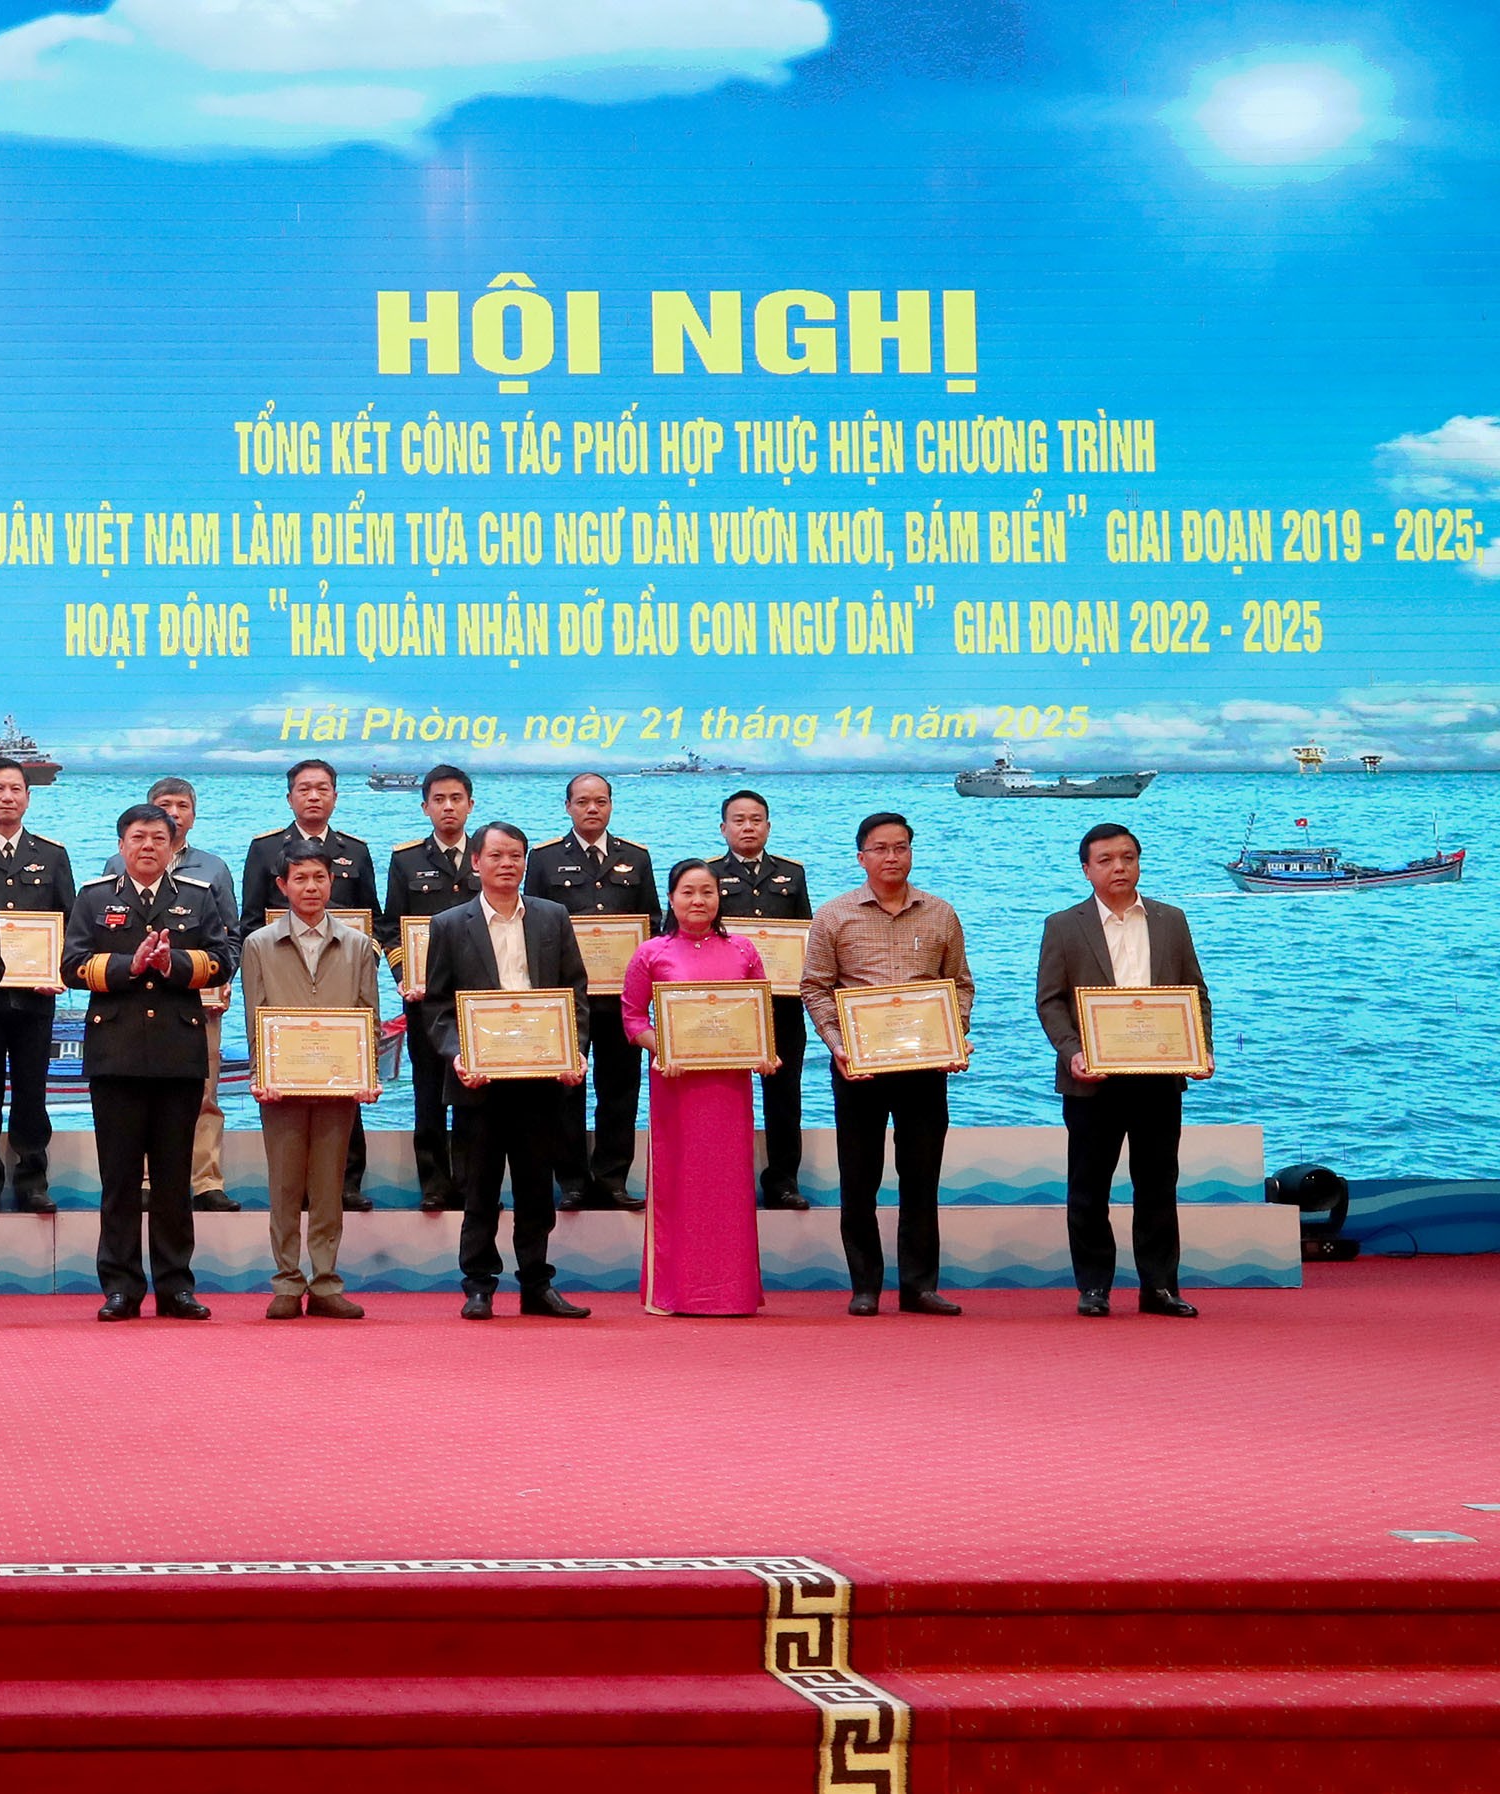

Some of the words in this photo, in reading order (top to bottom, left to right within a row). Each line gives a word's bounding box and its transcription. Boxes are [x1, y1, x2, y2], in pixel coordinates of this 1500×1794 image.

[378, 272, 601, 393] HỘI
[652, 289, 977, 393] NGHỊ
[235, 400, 320, 475] TỔNG
[332, 403, 391, 474] KẾT
[402, 411, 490, 475] CÔNG
[501, 410, 561, 474] TÁC
[574, 403, 648, 474] PHỐI
[661, 416, 724, 487] HỢP
[735, 415, 817, 486] THỰC
[830, 410, 904, 486] HIỆN
[917, 415, 1048, 473] CHƯƠNG
[1058, 408, 1155, 472] TRÌNH
[65, 501, 133, 577] VIỆT
[145, 513, 220, 565] NAM
[233, 501, 301, 565] LÀM
[312, 489, 395, 564] ĐIỂM
[406, 506, 468, 577] TỰA
[479, 511, 542, 565] CHO
[555, 507, 625, 565] NGƯ
[633, 500, 699, 564] DÂN
[710, 506, 797, 564] VƯƠN
[808, 506, 894, 570] KHƠI,
[906, 499, 979, 563] BÁM
[1106, 509, 1171, 563] GIAI
[1181, 509, 1272, 575] ĐOẠN
[1283, 509, 1361, 562] 2019
[1373, 533, 1384, 544] -
[1395, 508, 1485, 568] 2025;
[65, 602, 149, 670] HOẠT
[159, 592, 250, 670] ĐỘNG
[356, 591, 446, 662] QUÂN
[458, 591, 549, 669] NHẬN
[559, 588, 605, 656] ĐỠ
[613, 584, 679, 655] ĐẦU
[690, 602, 757, 655] CON
[769, 596, 839, 655] NGƯ
[955, 601, 1019, 654] GIAI
[1029, 600, 1119, 666] ĐOẠN
[1130, 601, 1210, 653] 2022
[1221, 625, 1232, 635] -
[1243, 600, 1323, 653] 2025
[280, 703, 349, 741] Hải
[362, 706, 507, 749] Phòng,
[524, 706, 626, 749] ngày
[639, 707, 683, 739] 21
[701, 705, 818, 748] tháng
[833, 706, 873, 738] 11
[890, 706, 978, 739] năm
[993, 705, 1089, 738] 2025
